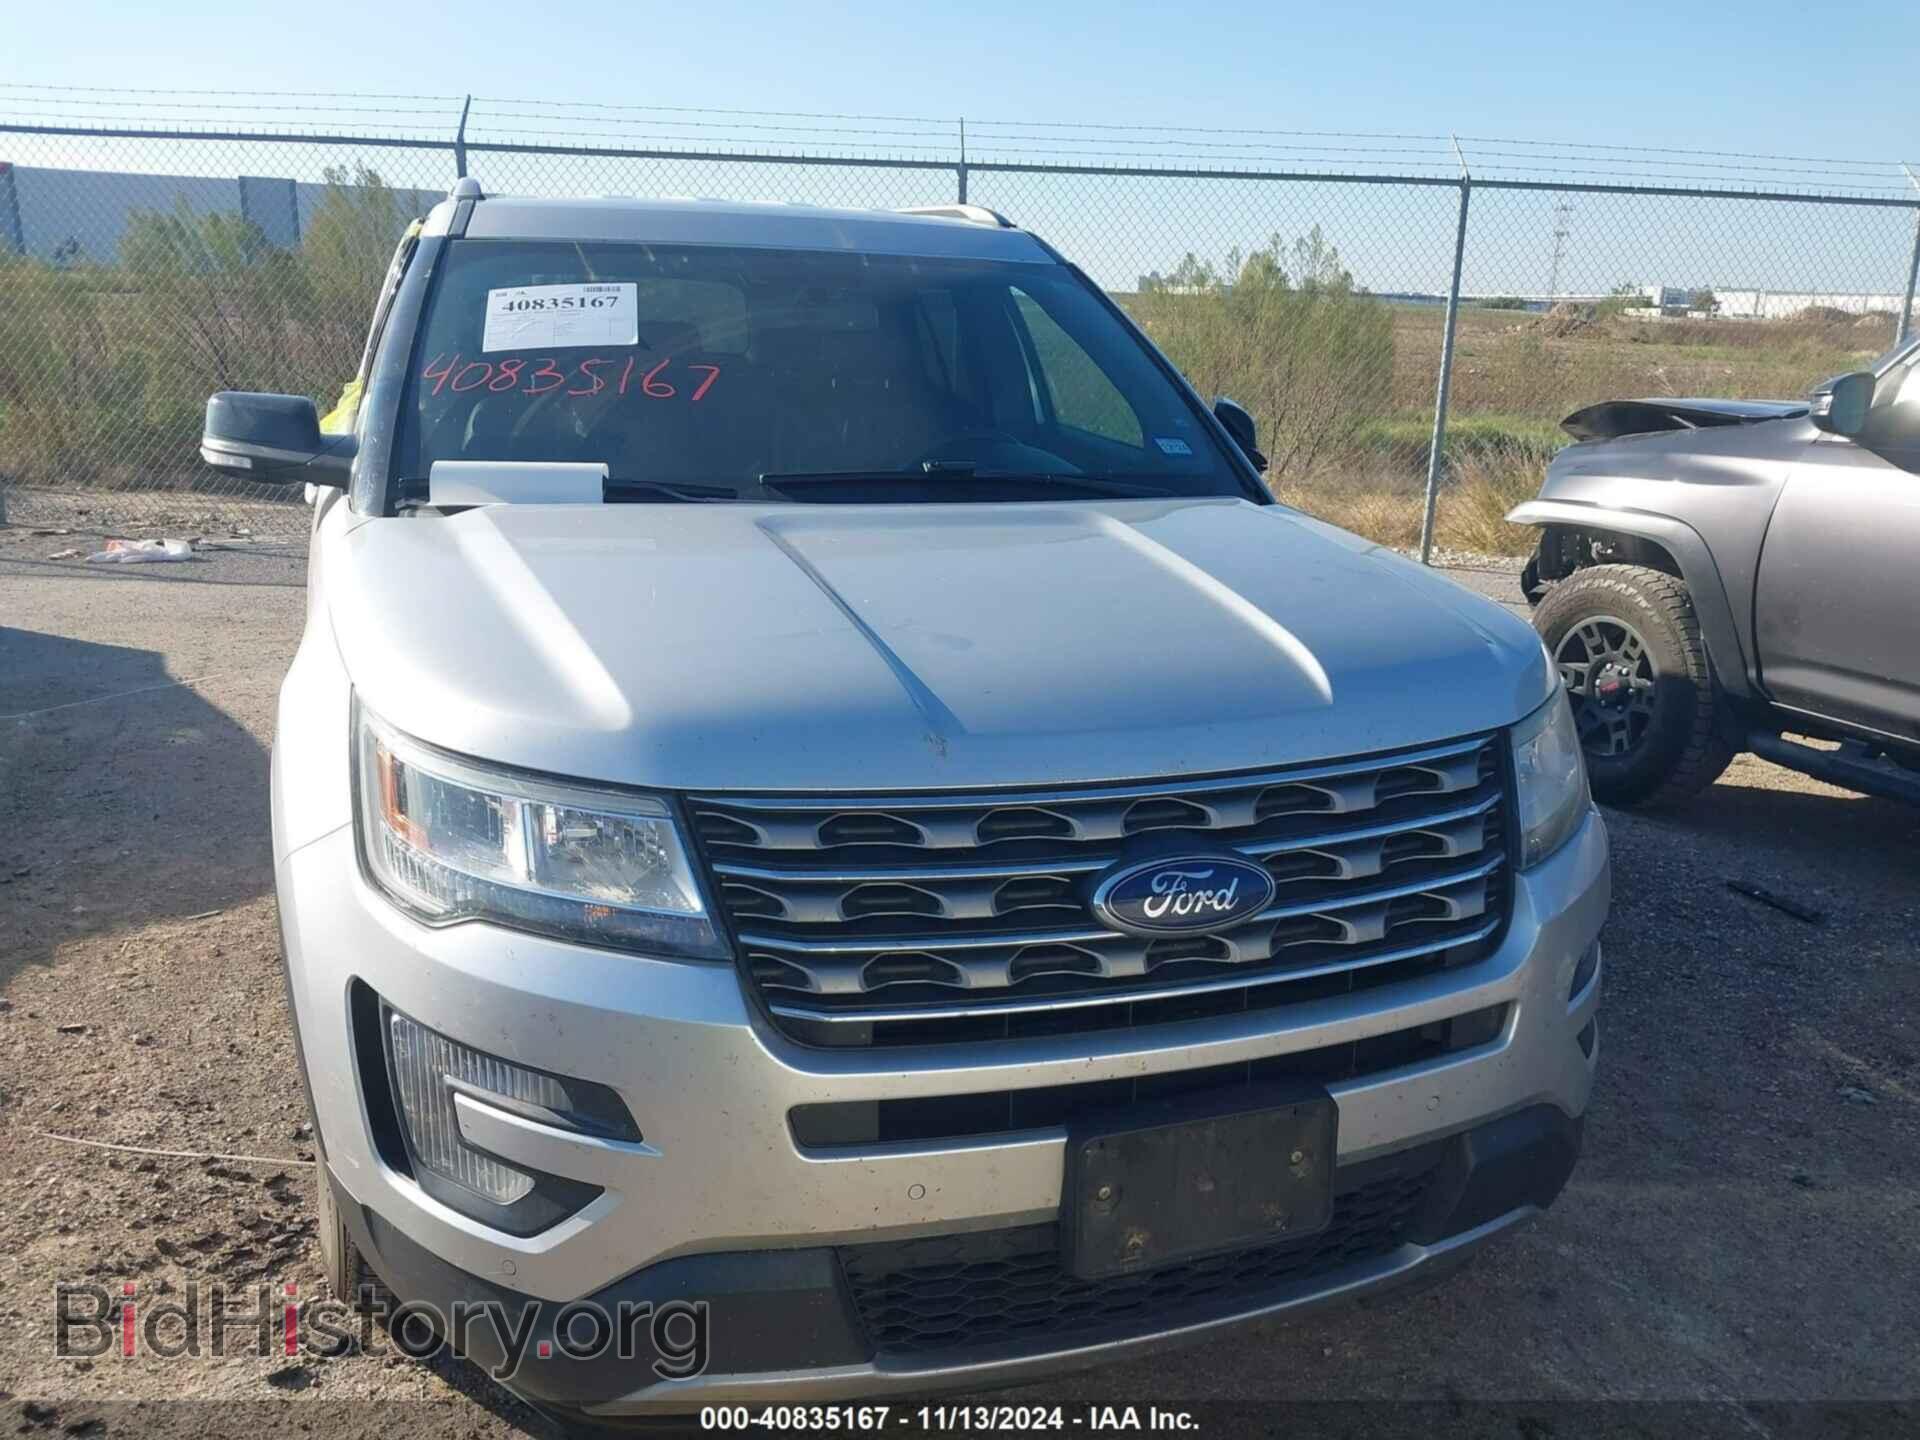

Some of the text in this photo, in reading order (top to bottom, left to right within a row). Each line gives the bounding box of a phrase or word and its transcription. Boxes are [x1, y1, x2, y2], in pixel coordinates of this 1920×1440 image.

[502, 296, 619, 312] 40835167
[421, 353, 720, 401] 40835167
[1143, 869, 1239, 918] Ford
